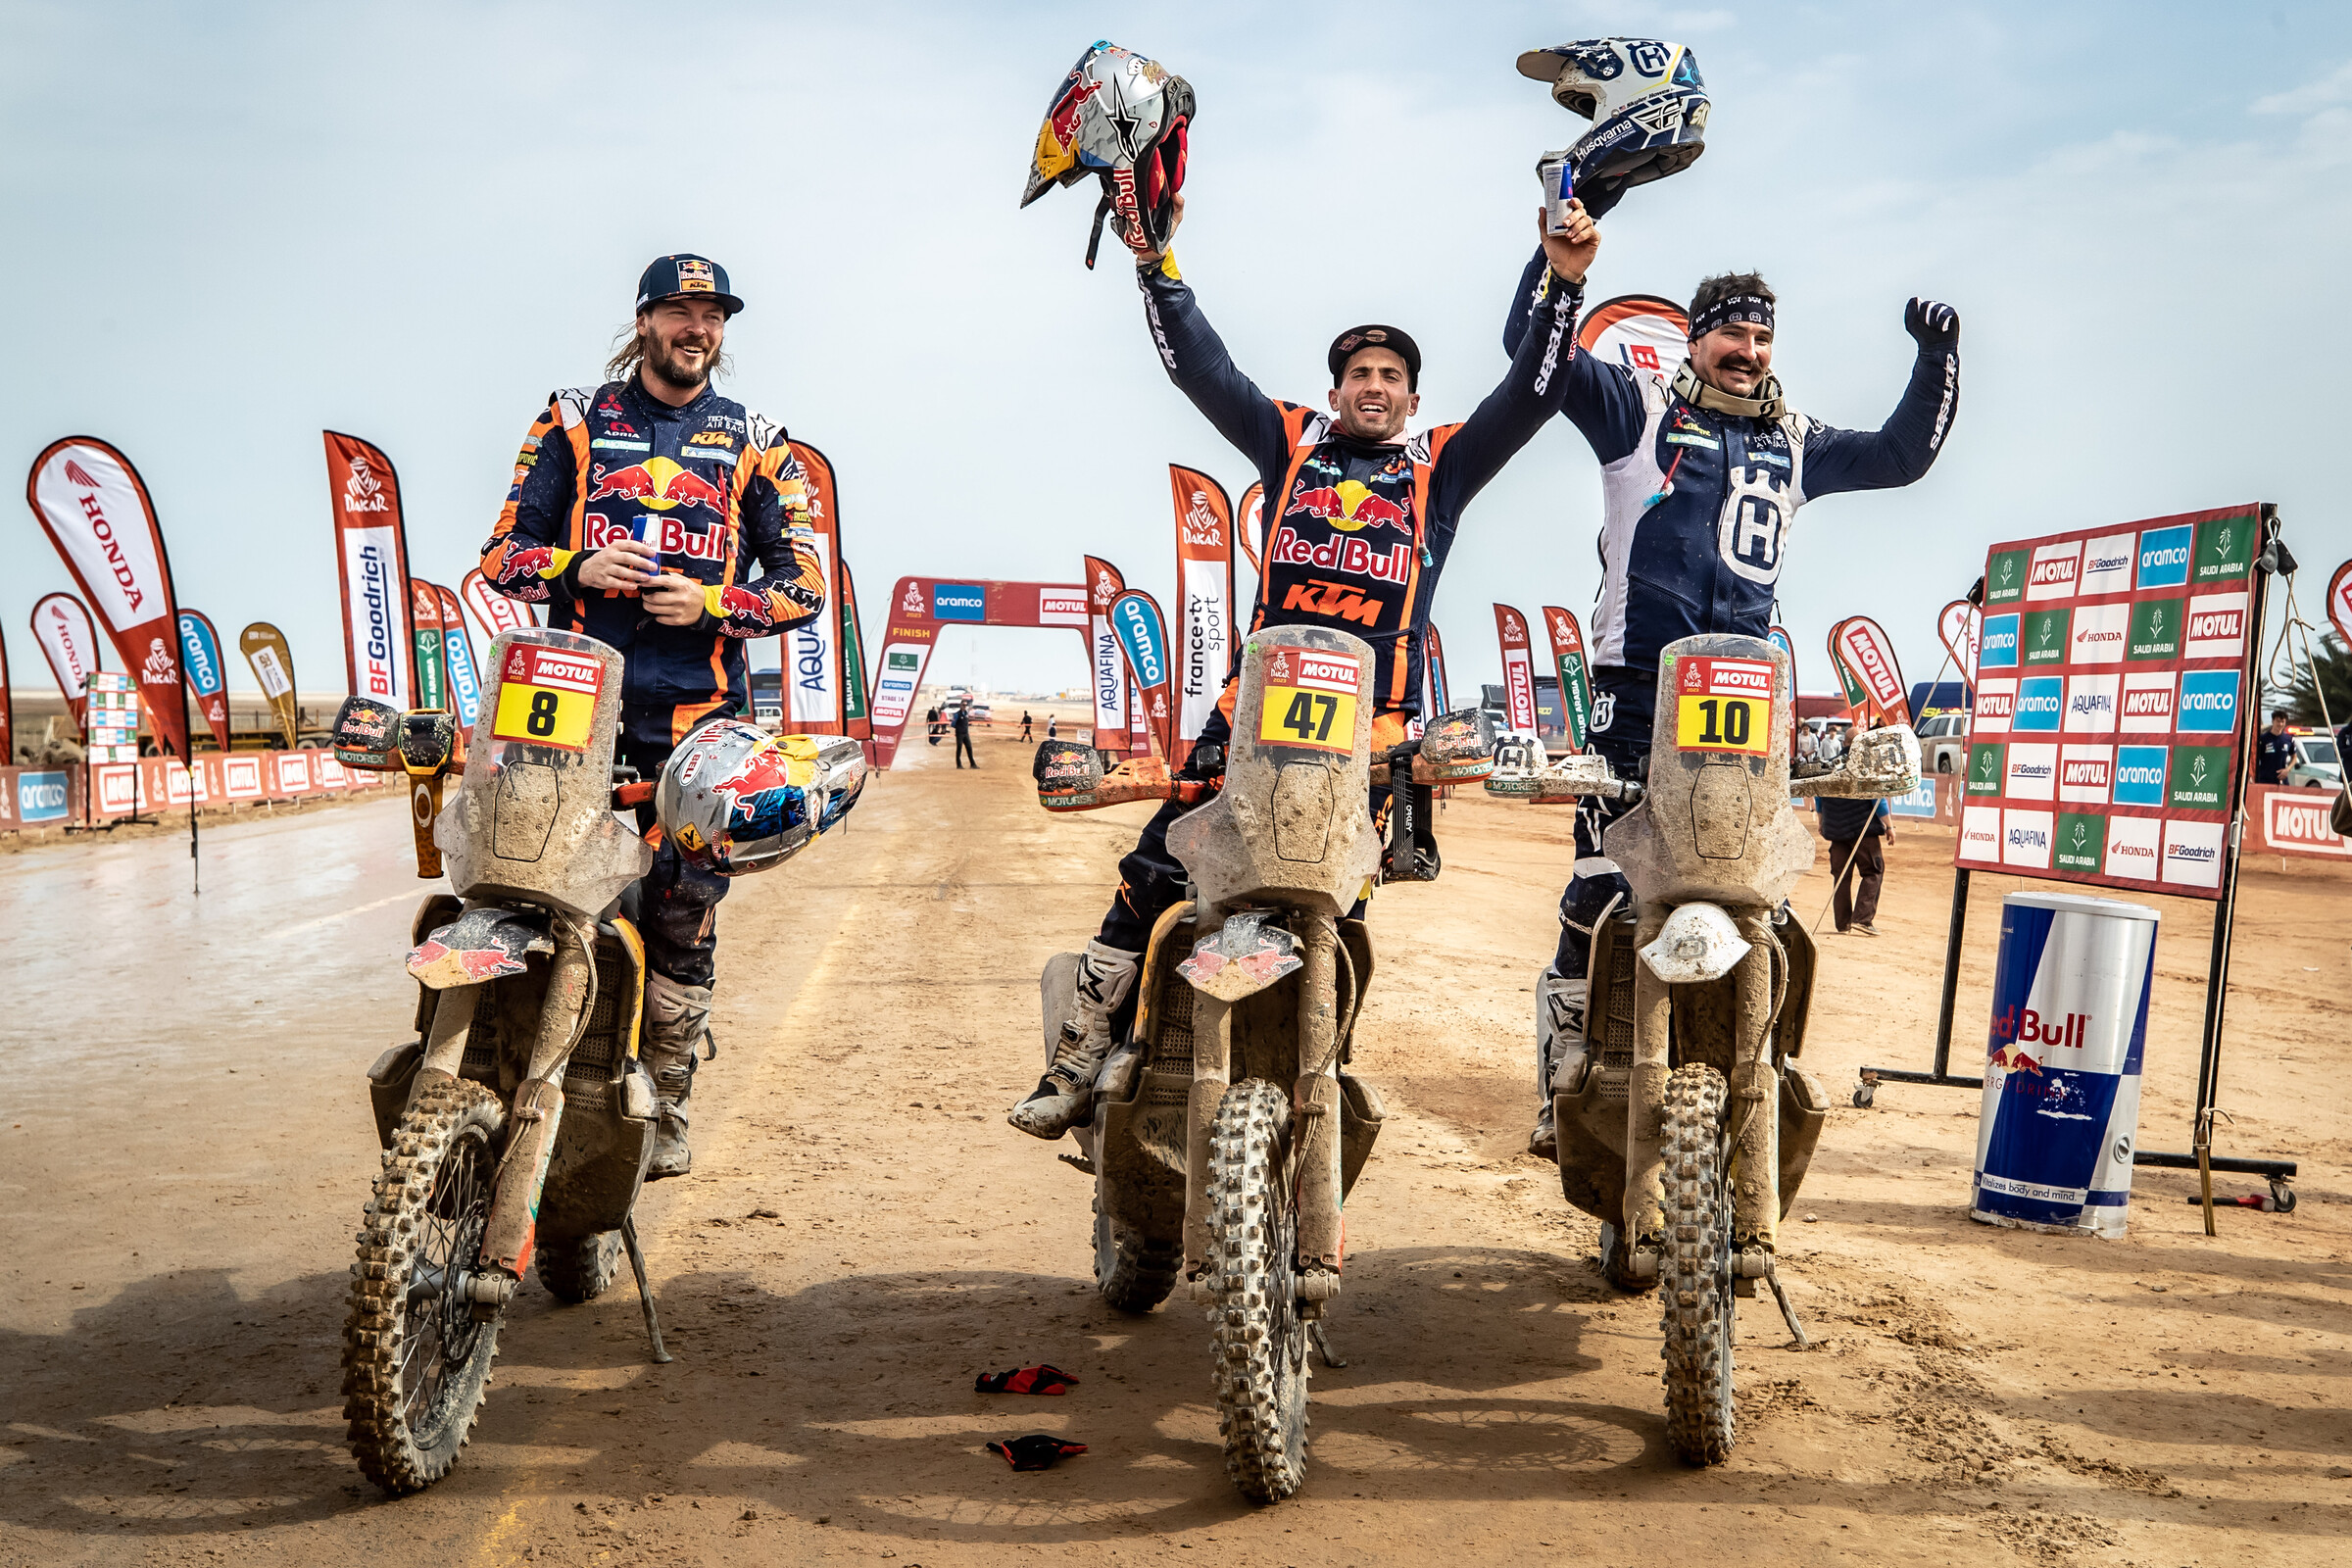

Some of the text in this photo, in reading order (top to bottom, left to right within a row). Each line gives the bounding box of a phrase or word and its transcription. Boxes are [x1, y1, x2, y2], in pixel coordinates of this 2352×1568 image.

[1627, 96, 1647, 108] Skyler
[1575, 120, 1633, 161] Husqvarna
[1113, 169, 1148, 248] Red Bull
[725, 423, 745, 433] BAG
[690, 431, 734, 448] KTM
[344, 493, 389, 514] DAKAR
[585, 513, 726, 562] Re Bull
[1183, 526, 1223, 547] DAKAR
[79, 492, 144, 614] HONDA
[1272, 526, 1410, 585] Red Bull
[2142, 547, 2187, 567] aramco
[2033, 559, 2075, 582] MOTUL
[2087, 555, 2129, 570] BFGoodrich
[2199, 563, 2243, 576] SAUDI ARABIA
[525, 581, 551, 602] Bull
[770, 579, 823, 612] KTM
[1989, 588, 2019, 600] SAUDI ARABIA
[903, 602, 925, 613] DAKAR
[937, 597, 982, 608] aramco
[1045, 601, 1086, 612] MOTUL
[1282, 579, 1384, 627] KTM
[360, 545, 389, 696] BFGoodrich
[1204, 597, 1225, 651] sport
[2192, 612, 2239, 638] MOTUL
[893, 627, 930, 638] FINISH
[1124, 601, 1159, 681] aramco
[1504, 633, 1524, 643] DAKAR
[1556, 635, 1577, 647] DAKAR
[1984, 632, 2015, 650] aramco
[2087, 632, 2123, 642] HONDA
[57, 623, 85, 685] HONDA
[179, 618, 216, 690] aramco
[798, 619, 826, 692] AQUA
[2029, 649, 2059, 661] SAUDI ARABIA
[2133, 643, 2175, 655] SAUDI ARABIA
[508, 665, 525, 677] DAKAR
[537, 662, 595, 682] MOTUL
[1100, 634, 1118, 710] AQUAFINA
[1271, 668, 1291, 678] DAKAR
[1301, 662, 1356, 683] MOTUL
[1851, 632, 1895, 699] MOTUL
[142, 669, 178, 685] DAKAR
[447, 637, 479, 717] aramco
[1684, 679, 1702, 688] DAKAR
[1714, 671, 1768, 688] MOTUL
[1512, 663, 1531, 725] MOTUL
[1571, 679, 1583, 712] ARABIA
[2126, 692, 2169, 713] MOTUL
[2182, 693, 2233, 710] aramco
[876, 708, 903, 716] MOTUL
[1977, 697, 2011, 714] MOTUL
[2018, 697, 2059, 712] aramco
[2071, 695, 2112, 714] AQUAFINA
[526, 691, 559, 737] 8
[1283, 691, 1339, 742] 47
[1698, 699, 1750, 745] 10
[341, 721, 385, 738] Red Bull
[1436, 734, 1483, 752] Red Bull
[339, 752, 384, 763] MOTOREX
[682, 754, 702, 781] BELL
[1046, 763, 1090, 779] Red Bull
[2011, 764, 2052, 776] BFGoodrich
[2065, 763, 2106, 783] MOTUL
[2118, 766, 2163, 785] aramco
[1493, 781, 1538, 791] MOTOREX
[1047, 794, 1093, 807] MOTOREX
[2174, 791, 2218, 803] SAUDI ARABIA
[1970, 832, 1995, 843] HONDA
[2008, 828, 2047, 850] AQUAFINA
[2059, 854, 2095, 866] SAUDI ARABIA
[2121, 845, 2155, 858] HONDA
[2169, 844, 2216, 858] BFGoodrich
[1990, 1004, 2015, 1039] ed
[1986, 1075, 2011, 1091] ERGY
[1982, 1177, 2077, 1201] Vitalizes body and mind.
